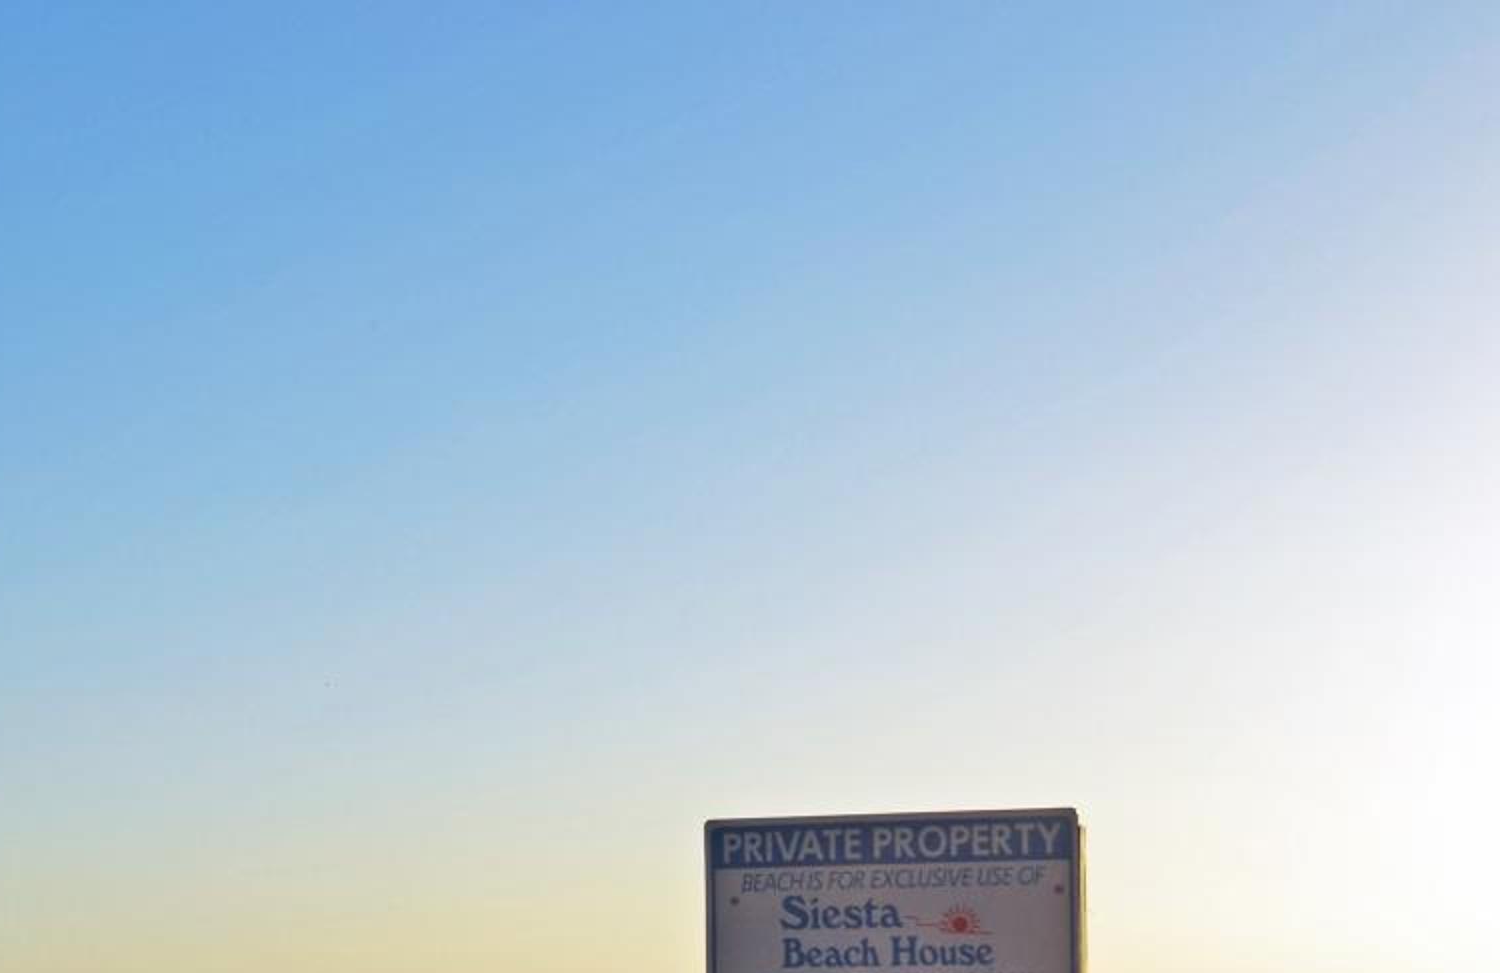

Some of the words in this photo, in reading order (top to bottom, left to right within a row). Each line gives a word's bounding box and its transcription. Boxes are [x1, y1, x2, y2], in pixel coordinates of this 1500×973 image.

[723, 829, 861, 864] PRIVATE
[873, 823, 1060, 860] PROPERTY
[741, 872, 801, 895] BEACH
[807, 871, 823, 889] IS
[828, 869, 864, 889] FOR
[870, 868, 972, 888] EXCLUSIVE
[977, 867, 1014, 886] USE
[1018, 866, 1045, 885] OF
[780, 896, 903, 930] Siesta
[782, 938, 878, 968] Beach
[888, 937, 993, 966] House
